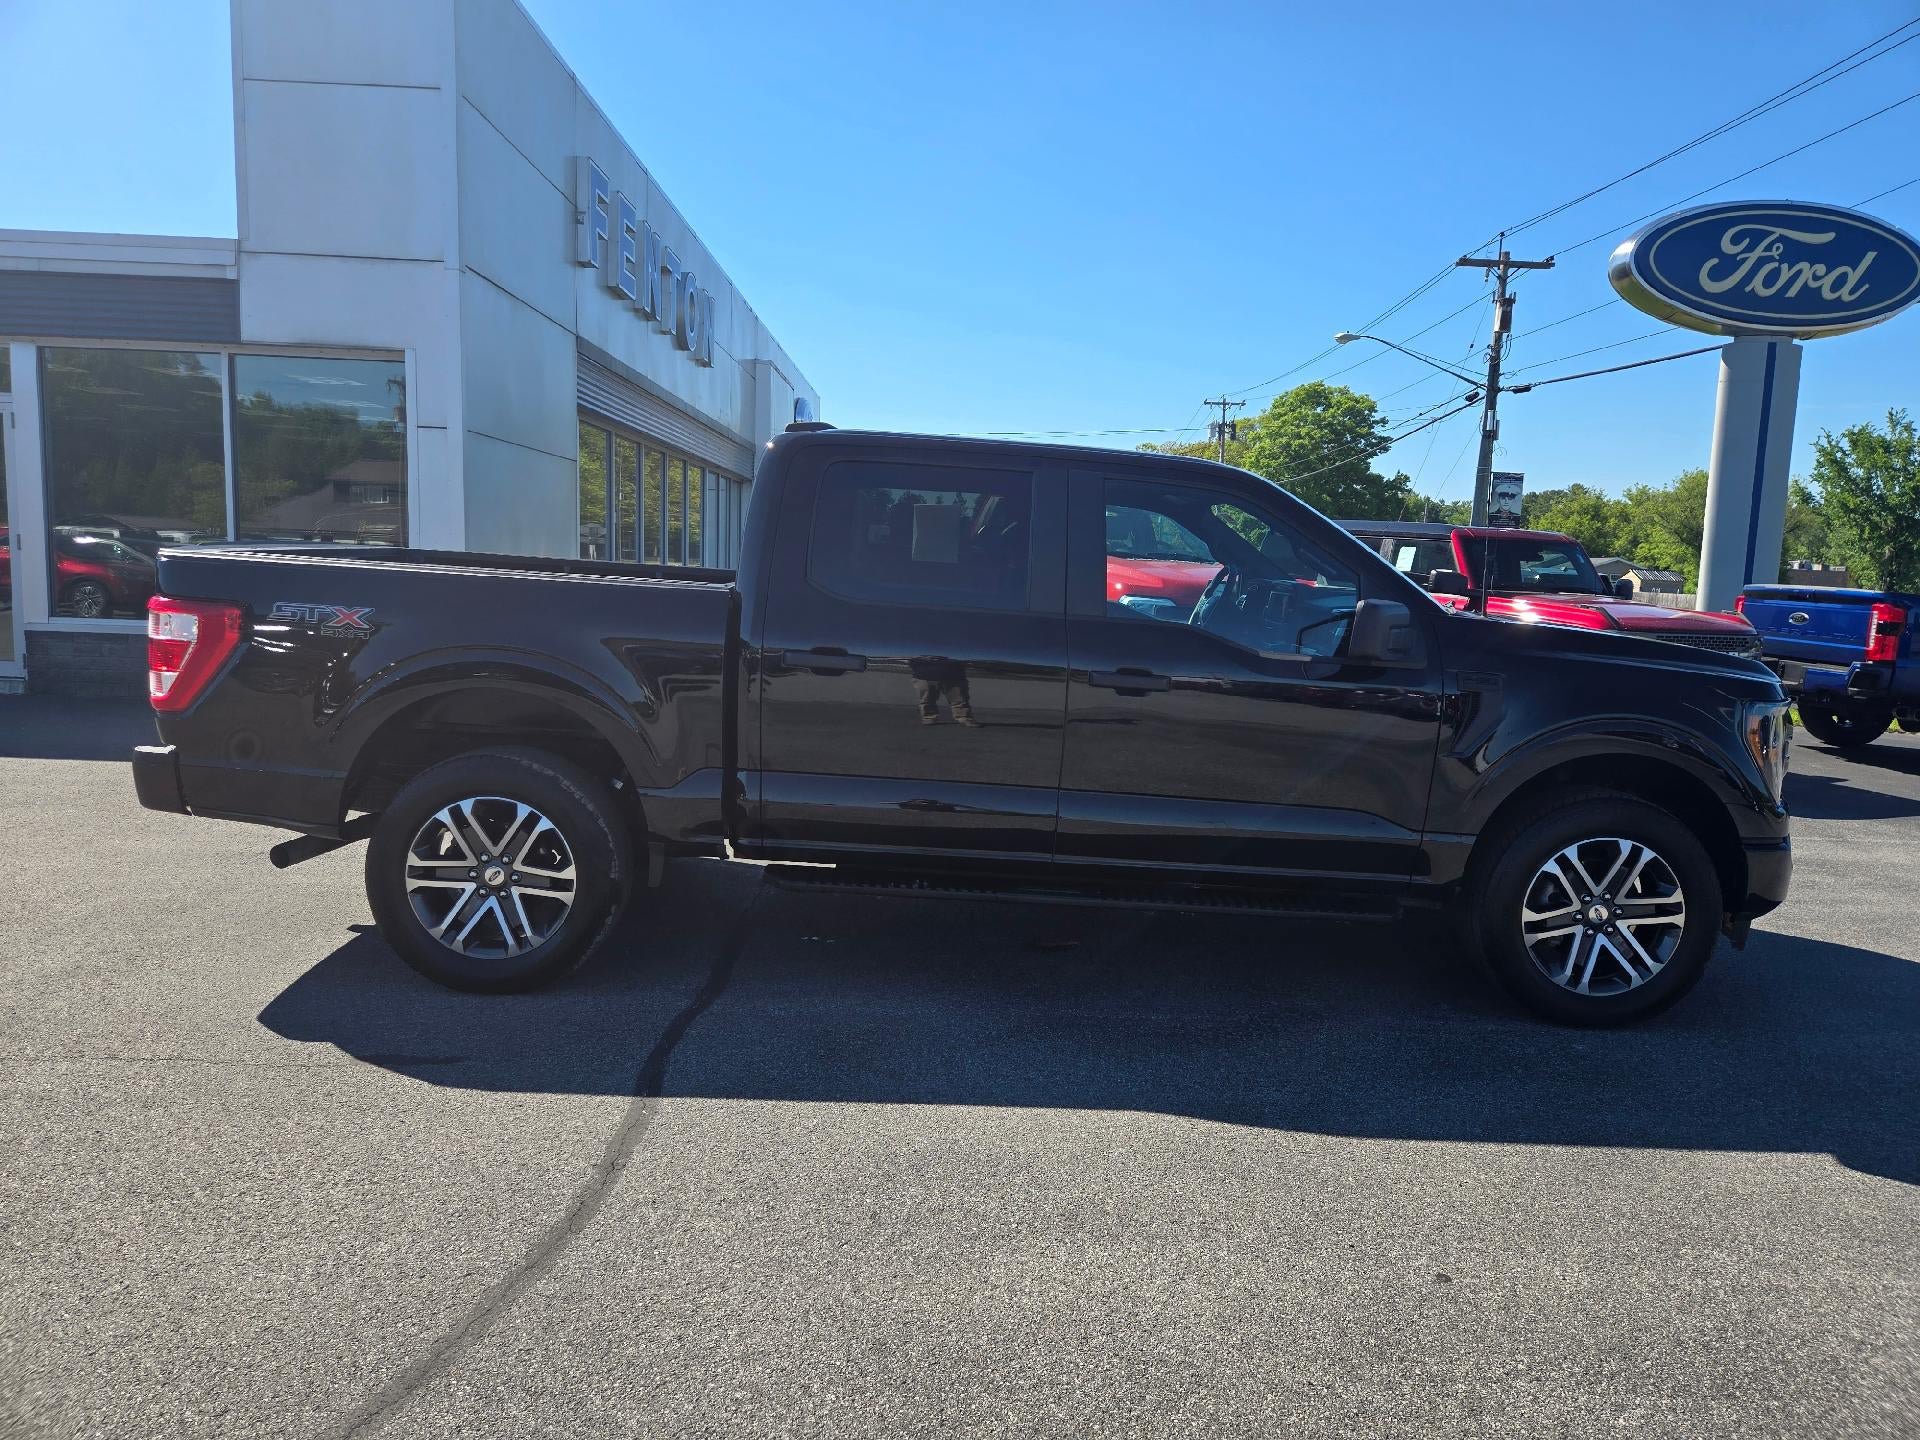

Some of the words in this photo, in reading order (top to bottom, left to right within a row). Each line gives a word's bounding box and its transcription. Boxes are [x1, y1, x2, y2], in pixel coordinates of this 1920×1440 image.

[577, 156, 716, 368] FENTON
[1699, 224, 1878, 302] Ford
[267, 602, 376, 631] STX
